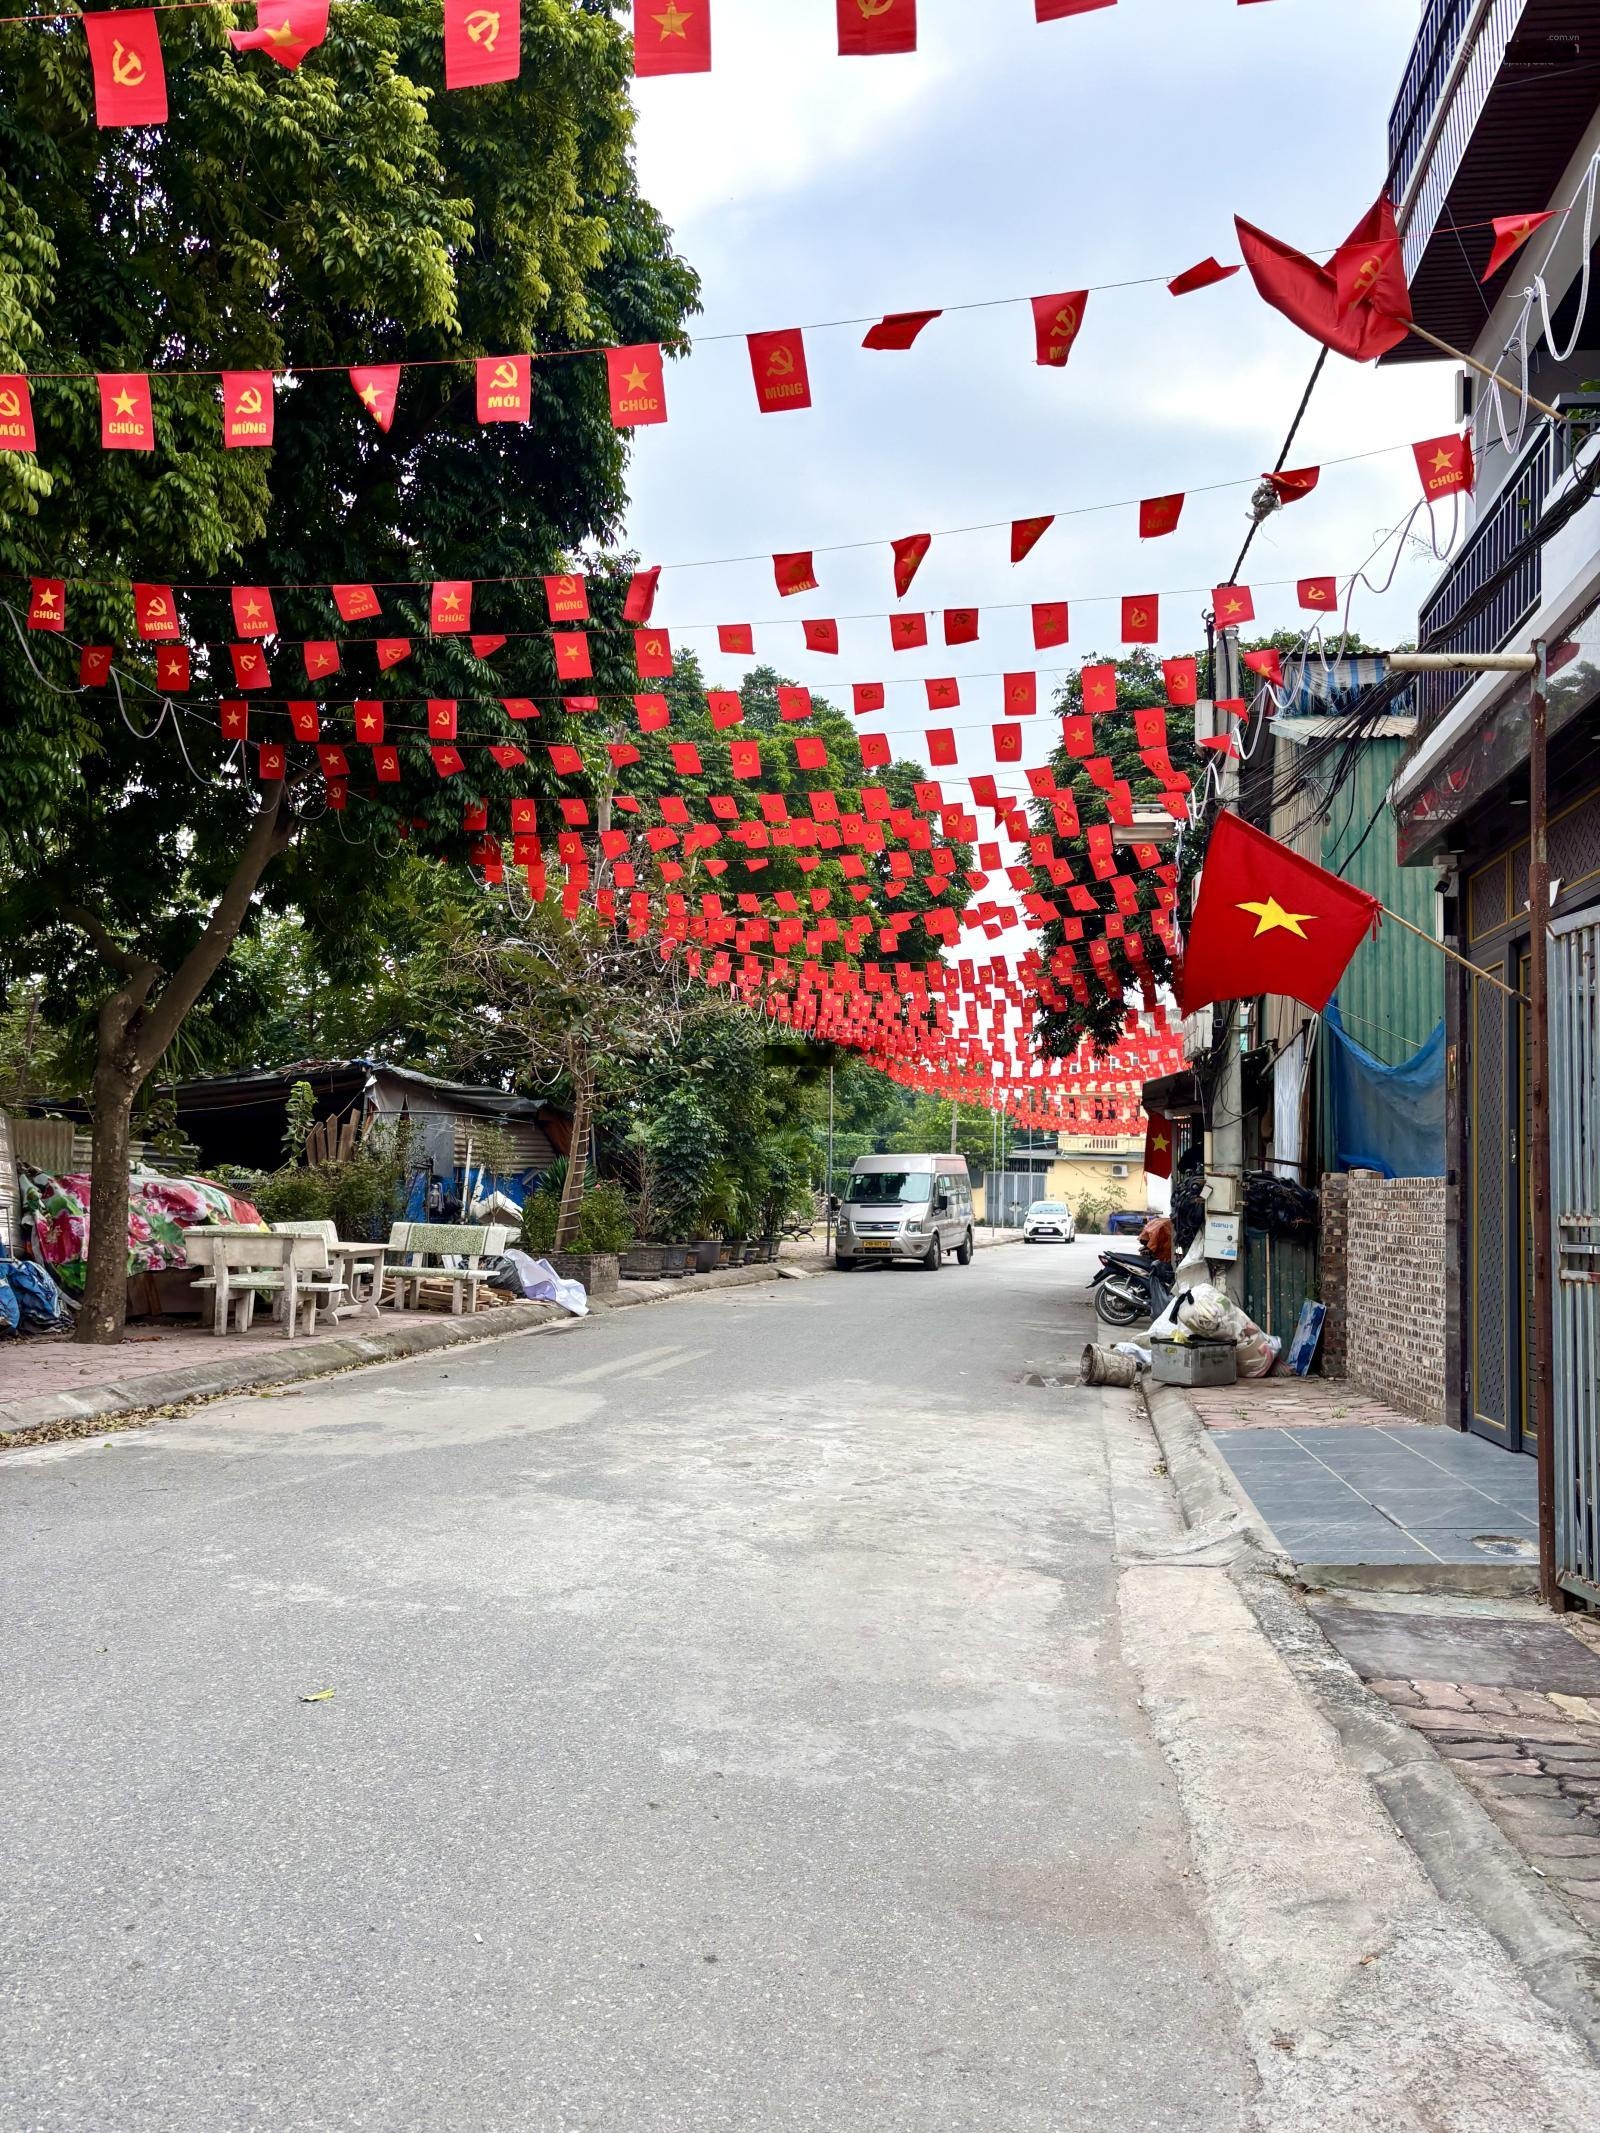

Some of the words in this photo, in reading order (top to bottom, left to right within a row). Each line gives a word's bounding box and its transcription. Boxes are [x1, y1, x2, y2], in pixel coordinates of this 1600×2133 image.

[487, 394, 520, 408] MỚI
[619, 396, 658, 412] CHÚC
[108, 421, 144, 435] CHÚC
[231, 421, 267, 436] MỪNG
[1429, 470, 1464, 489] CHÚC
[33, 609, 61, 621] CHÚC
[437, 613, 465, 623] CHÚC
[144, 620, 174, 632] MỪNG
